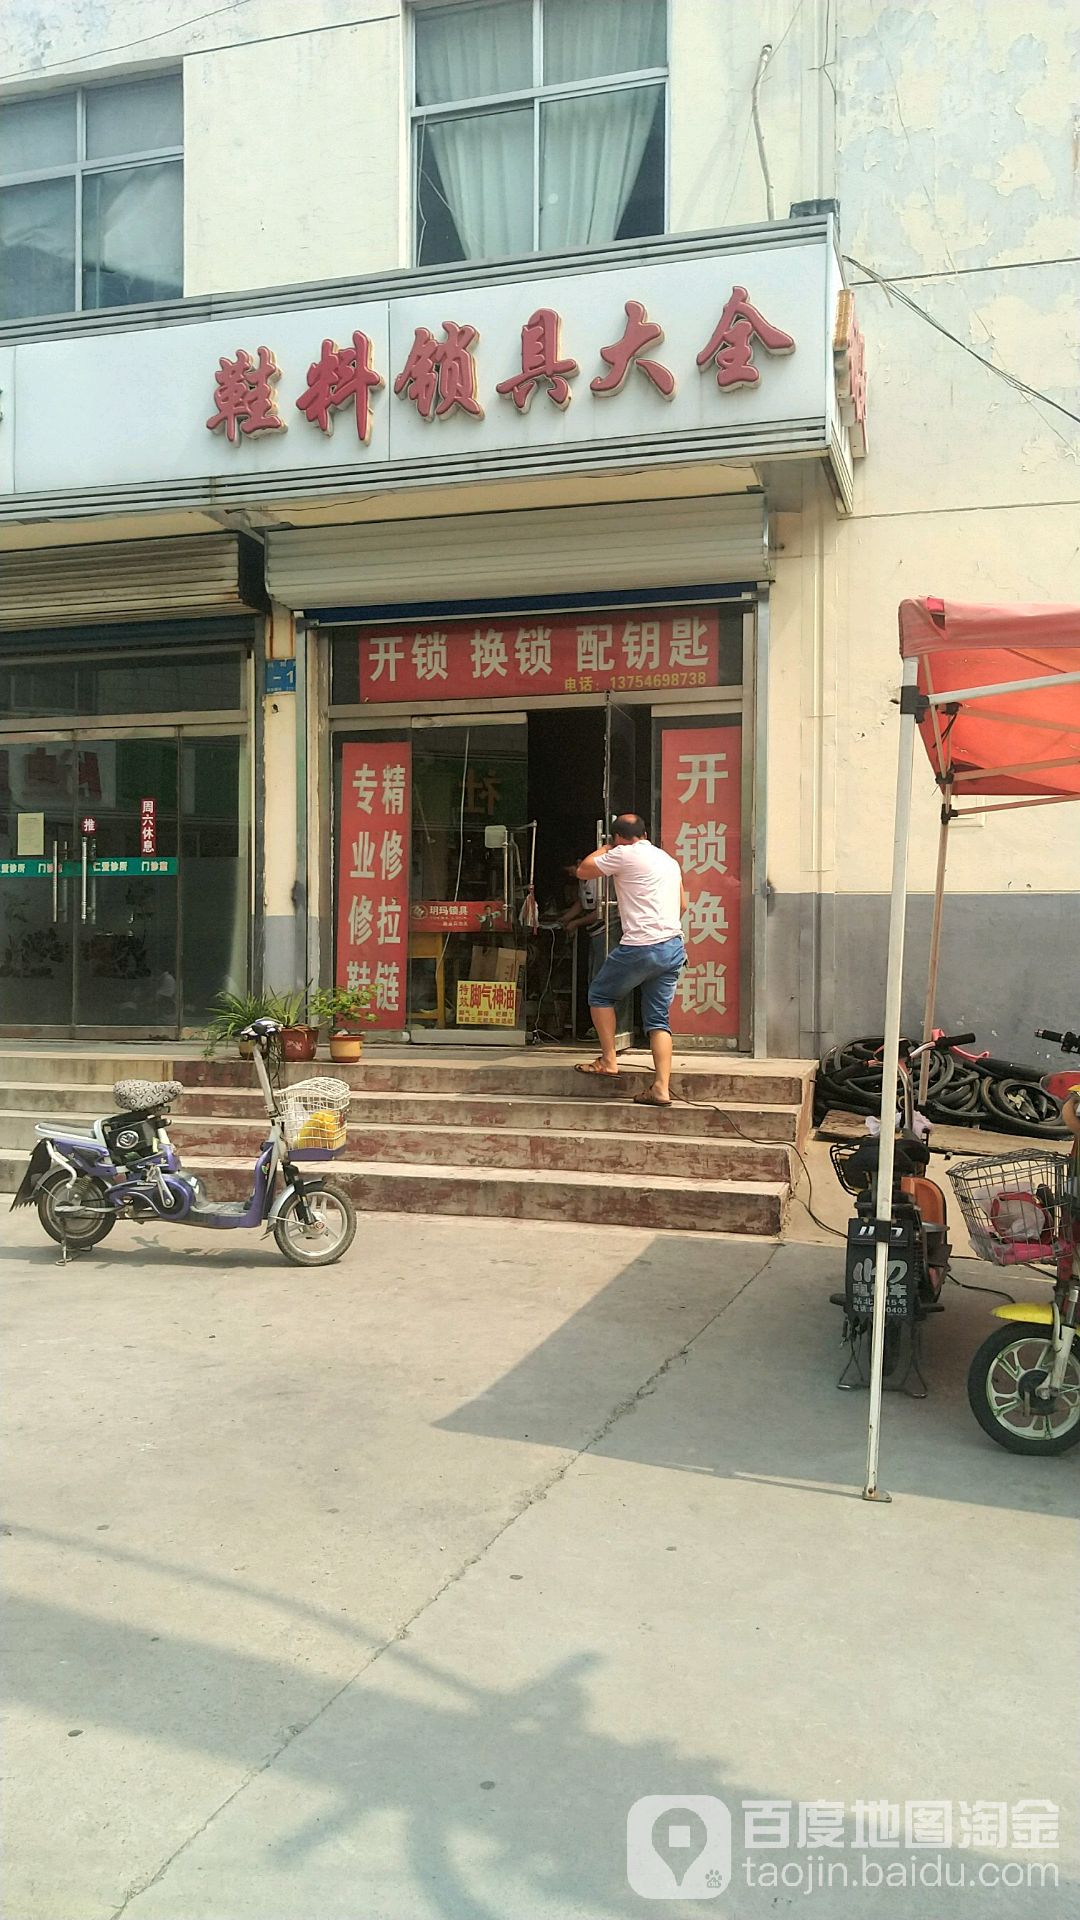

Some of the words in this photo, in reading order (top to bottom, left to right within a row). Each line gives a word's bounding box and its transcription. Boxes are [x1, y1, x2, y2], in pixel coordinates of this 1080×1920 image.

[206, 285, 797, 447] 鞋料锁具大全
[368, 633, 449, 682] 开锁
[470, 624, 553, 679] 换锁
[576, 616, 709, 672] 配钥匙
[609, 671, 707, 690] 13754698738
[83, 818, 96, 832] 推
[141, 800, 155, 853] 周六休息
[374, 763, 406, 1012] 精修拉链
[673, 752, 729, 1016] 开锁换锁
[469, 983, 515, 1011] 脚气神油
